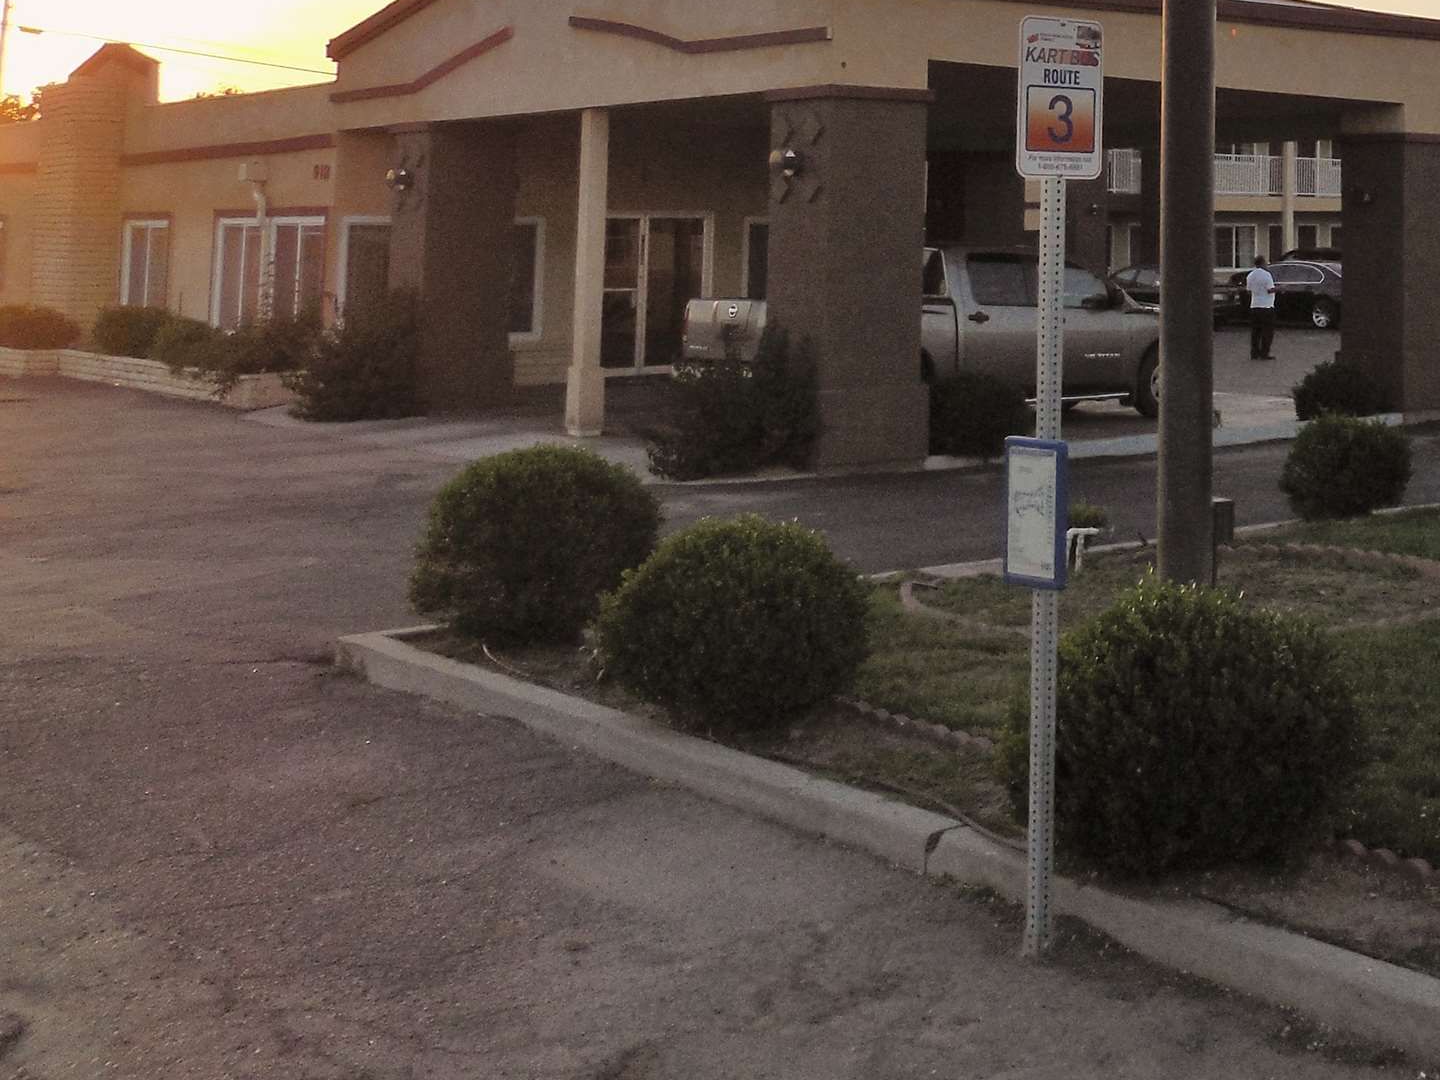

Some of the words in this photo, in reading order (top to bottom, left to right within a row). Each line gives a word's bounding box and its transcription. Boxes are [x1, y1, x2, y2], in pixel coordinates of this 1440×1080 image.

[1025, 46, 1068, 65] KART
[1043, 68, 1081, 86] ROUTE
[1047, 94, 1074, 145] 3
